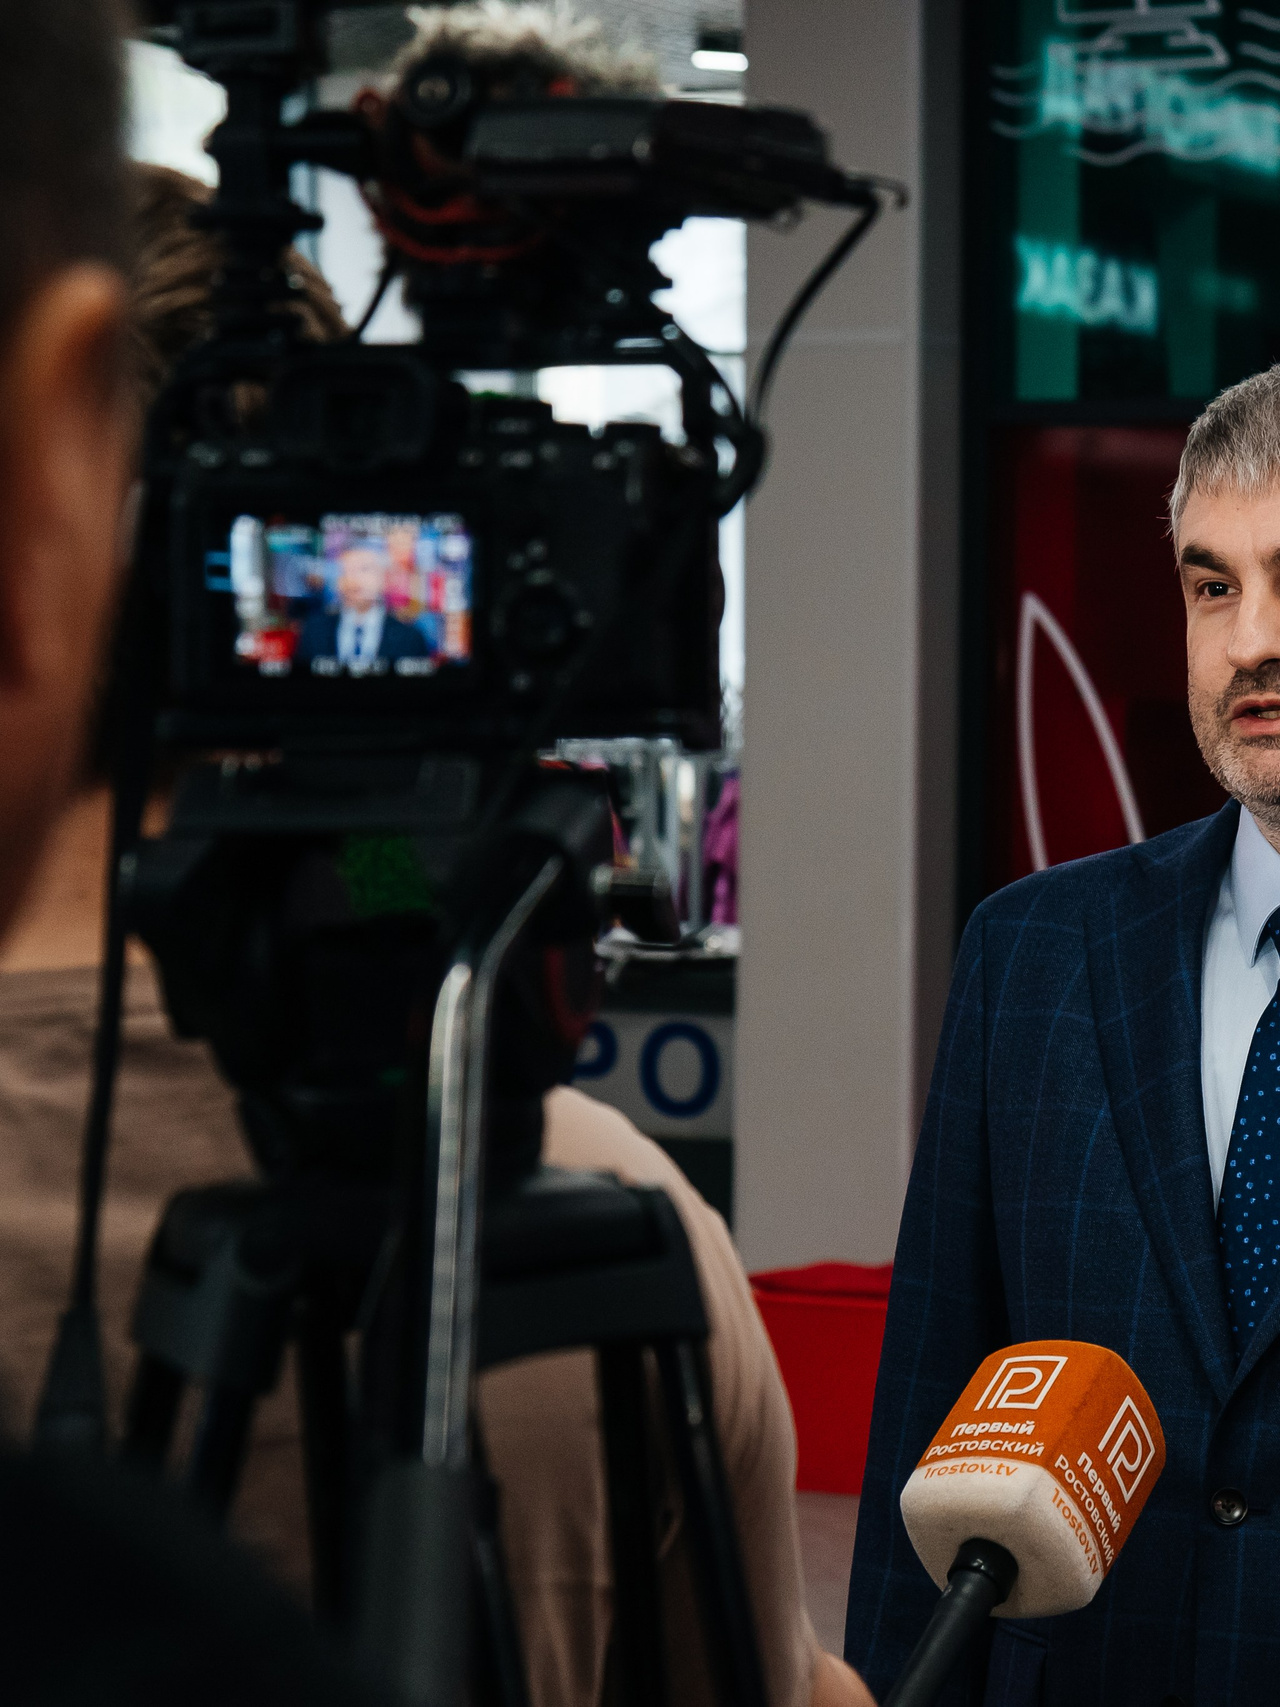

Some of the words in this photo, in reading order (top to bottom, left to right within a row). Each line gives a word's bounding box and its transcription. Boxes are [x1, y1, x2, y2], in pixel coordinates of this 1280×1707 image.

[950, 1420, 1036, 1438] Первый
[923, 1460, 1019, 1480] 1rostov.tv
[1077, 1451, 1122, 1534] Первый
[1051, 1486, 1099, 1575] 1rostov.tv
